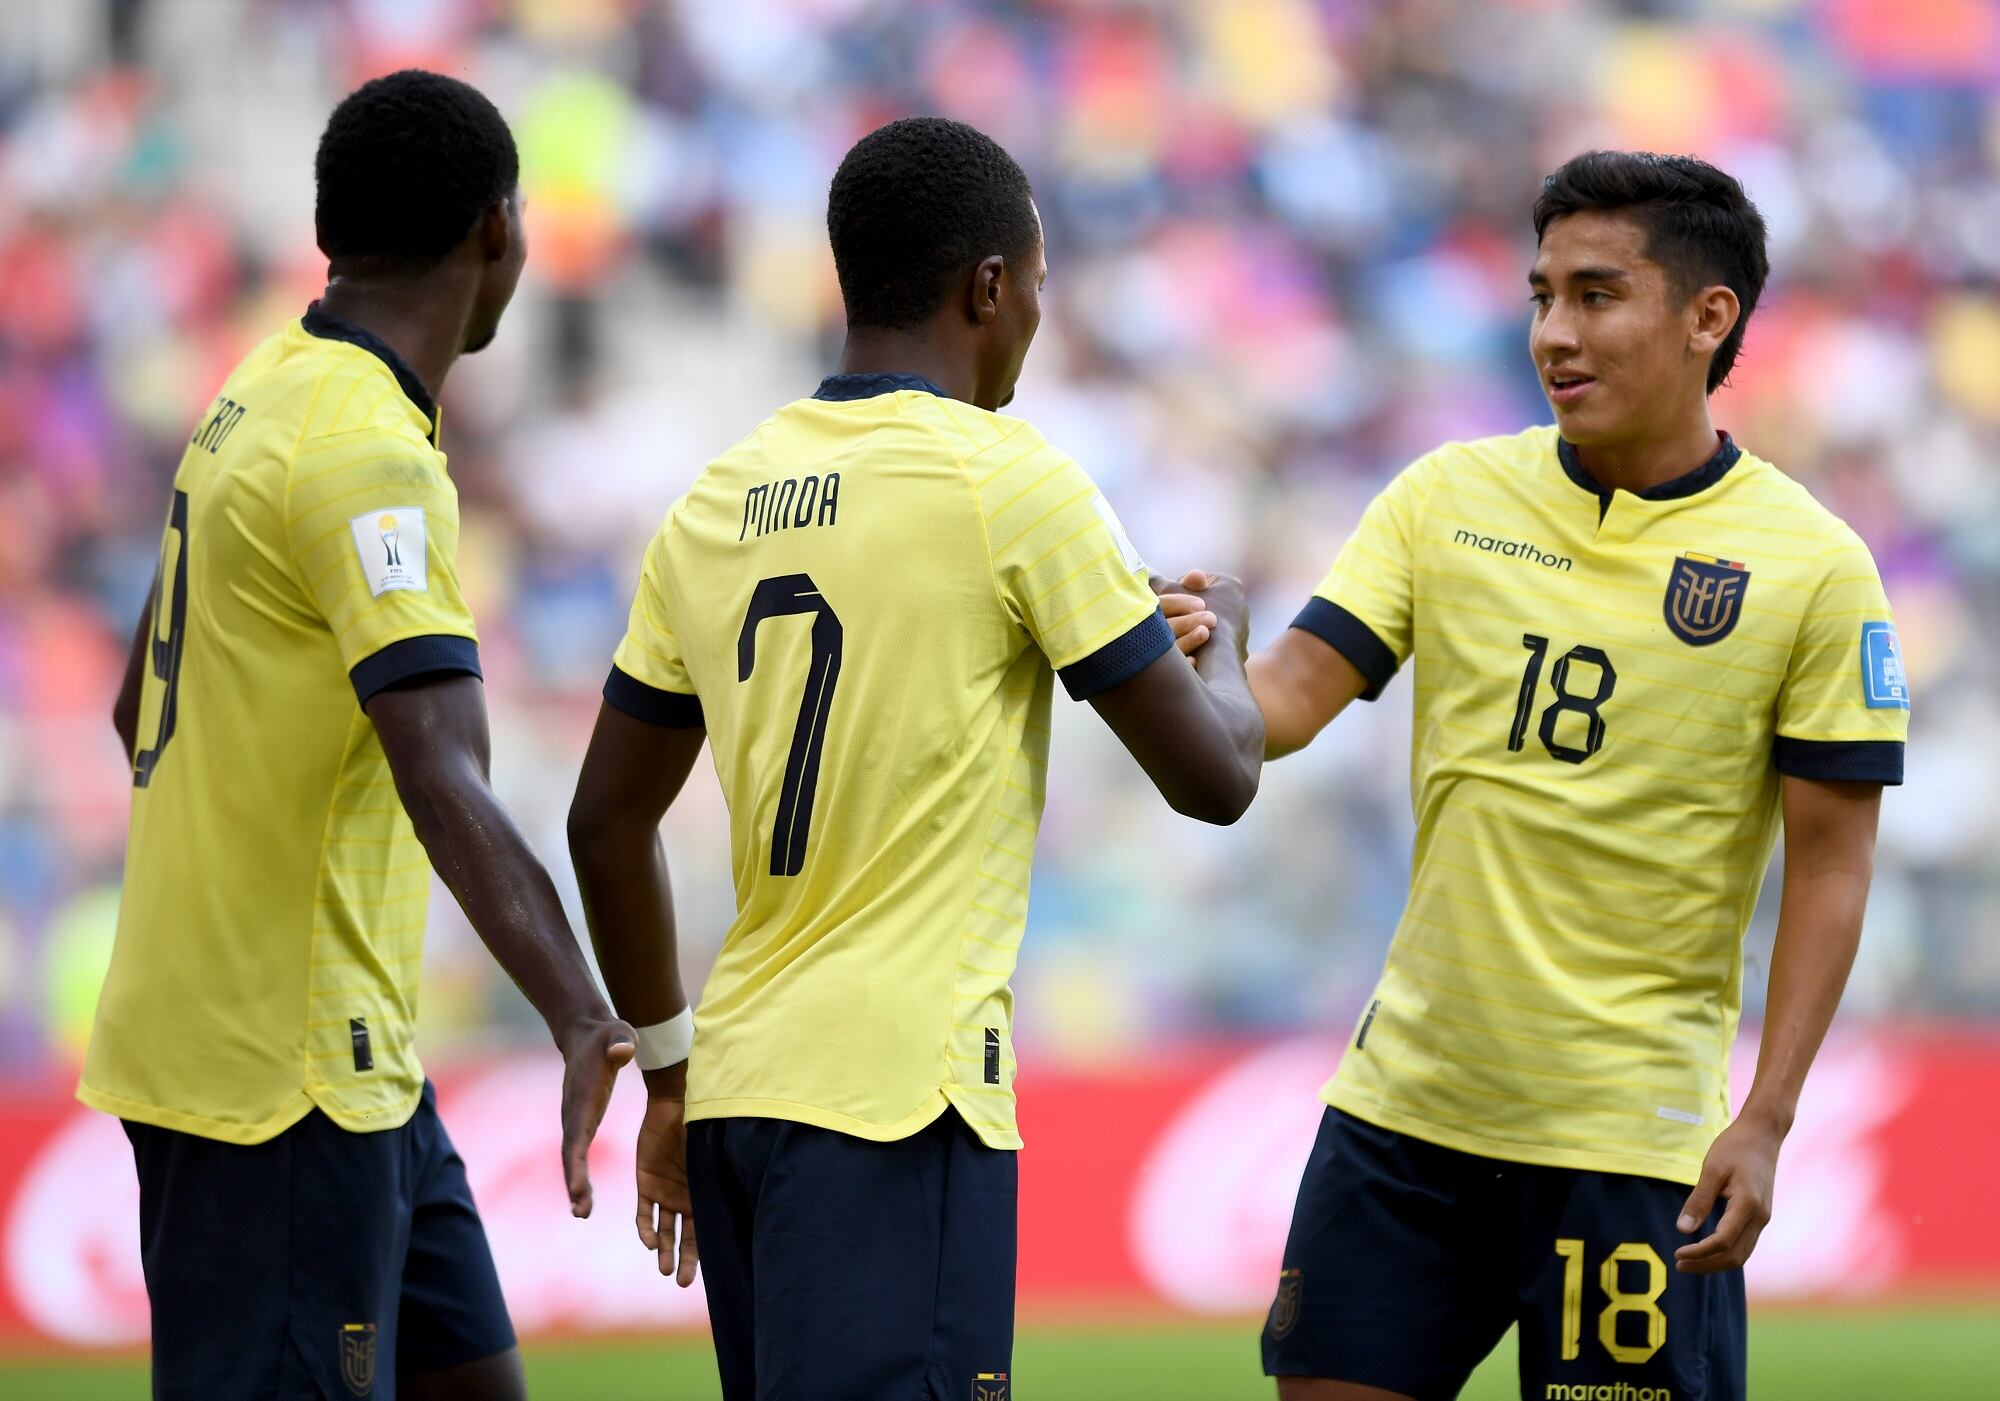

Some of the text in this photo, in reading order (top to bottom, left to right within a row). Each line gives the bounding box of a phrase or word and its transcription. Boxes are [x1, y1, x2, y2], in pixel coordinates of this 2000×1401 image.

[739, 473, 840, 541] MINDA
[1454, 529, 1573, 572] marathon
[738, 573, 843, 877] 7
[1508, 633, 1617, 765] 18
[1555, 1238, 1667, 1364] 18
[1545, 1381, 1671, 1401] marathon
